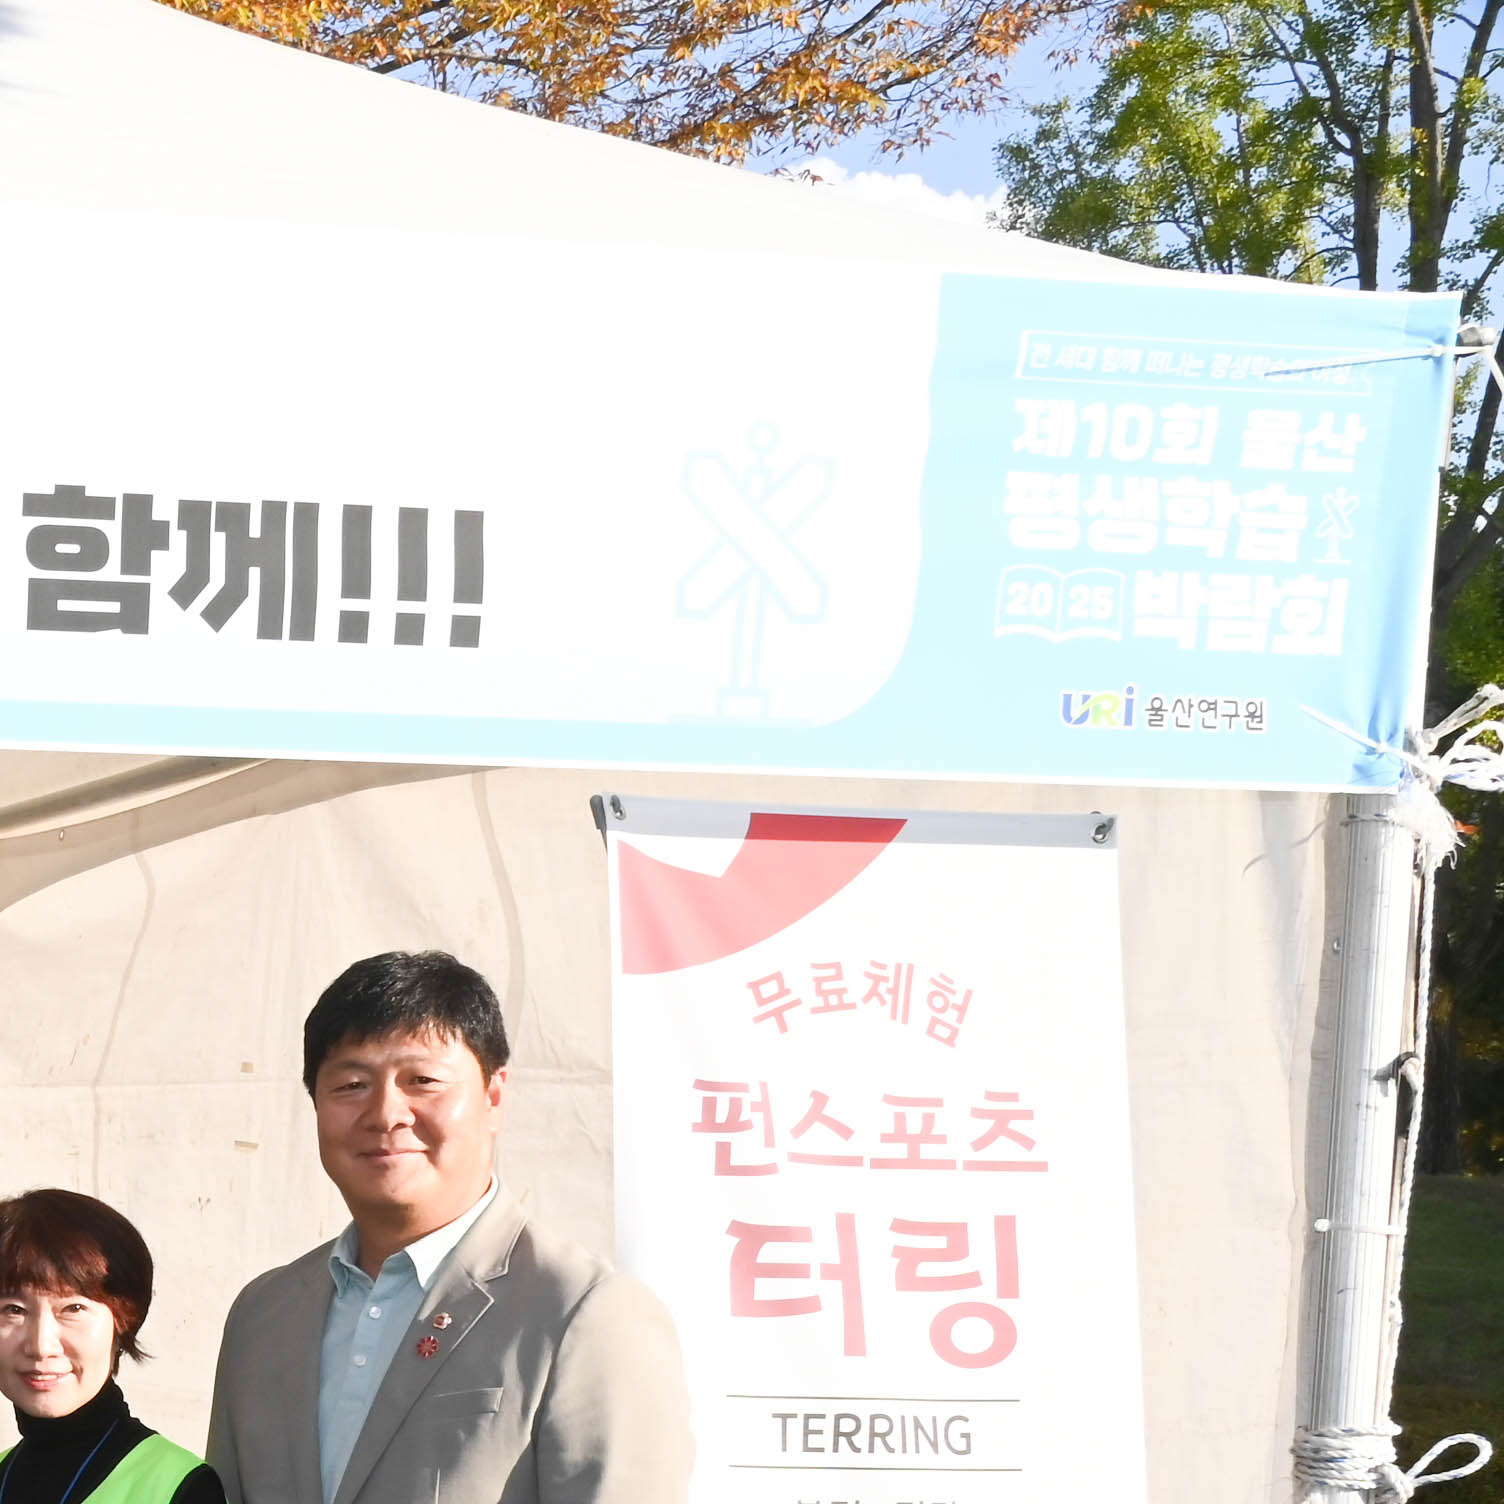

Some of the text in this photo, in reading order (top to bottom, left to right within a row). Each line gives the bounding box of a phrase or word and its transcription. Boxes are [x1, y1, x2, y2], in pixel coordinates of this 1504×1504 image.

[1012, 397, 1368, 472] 제10회 울산
[1002, 470, 1310, 563] 평생학습
[22, 485, 484, 648] 함께!!!
[1006, 570, 1349, 656] 20 25 박람회
[1144, 696, 1266, 731] 울산연구원
[745, 959, 974, 1048] 무료체험
[691, 1078, 1048, 1178] 펀스포츠
[725, 1213, 1020, 1370] 터링
[772, 1412, 973, 1457] TERRING
